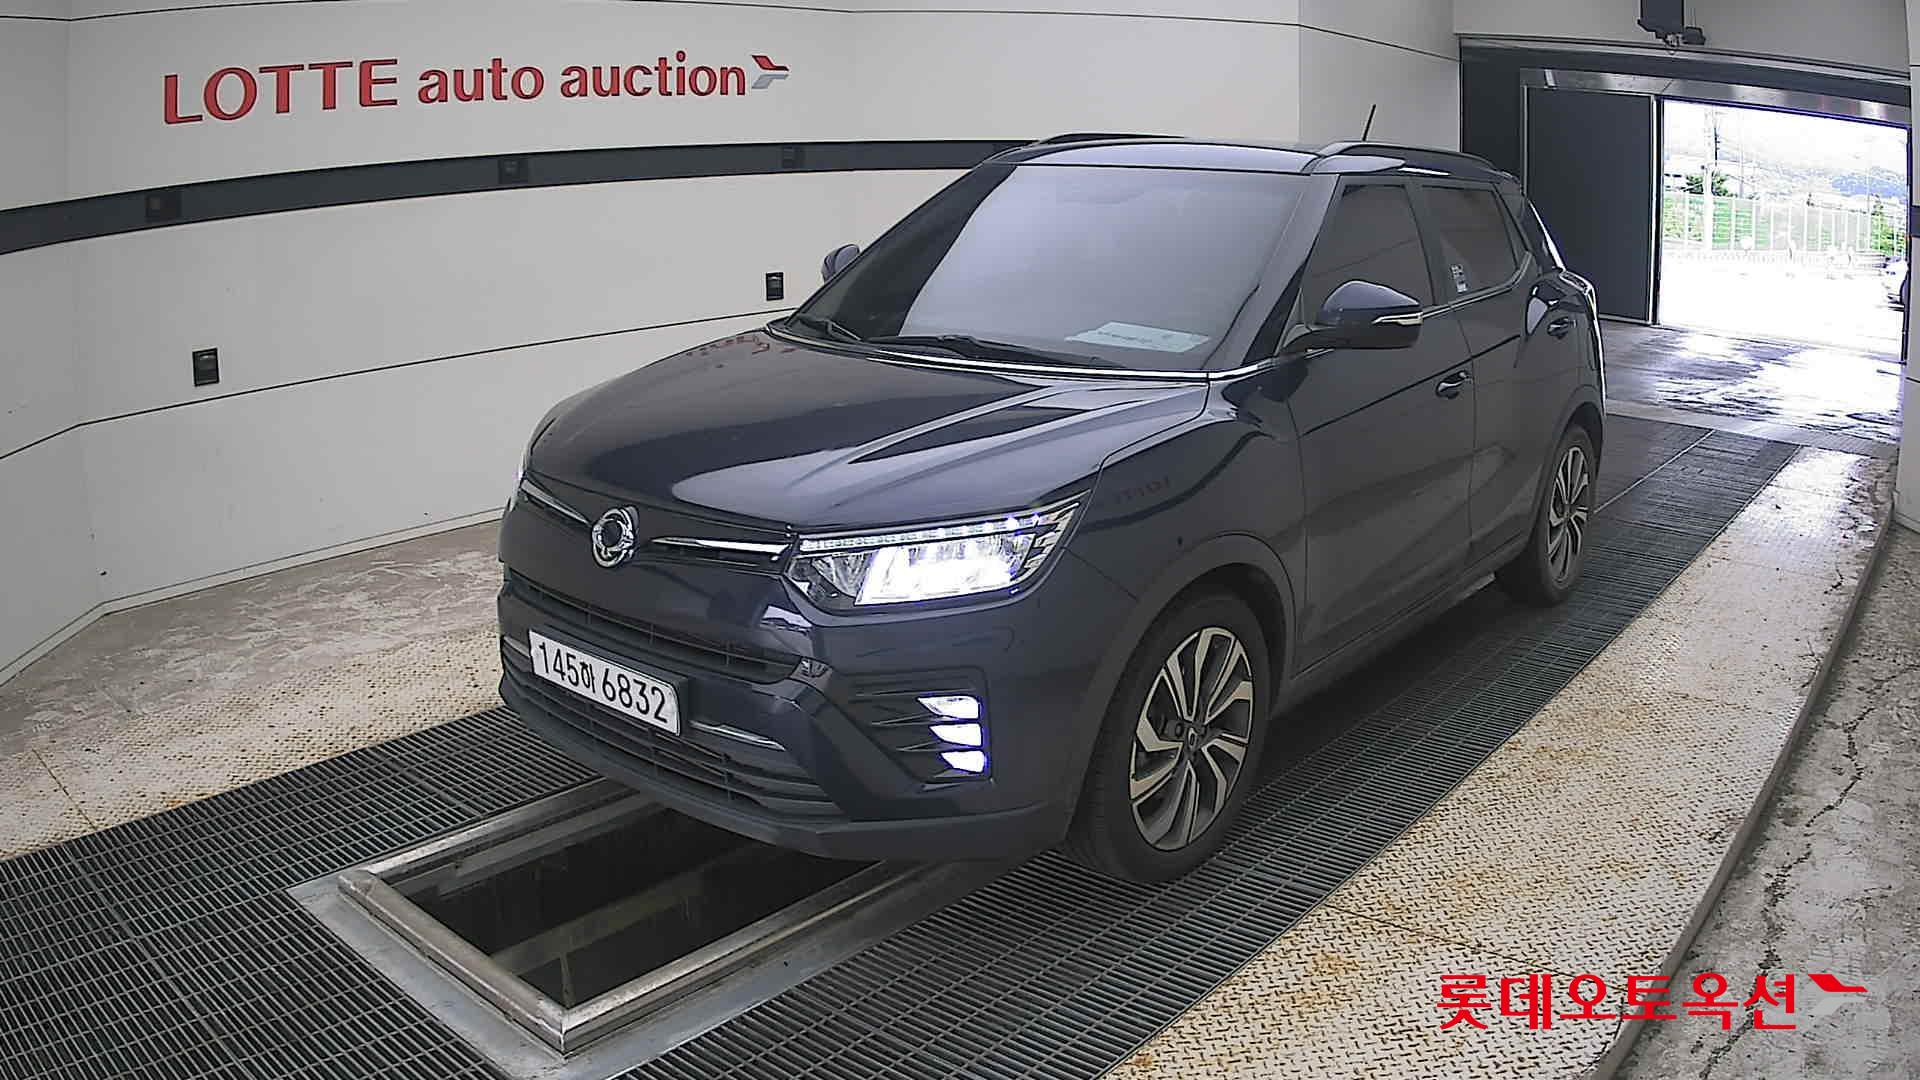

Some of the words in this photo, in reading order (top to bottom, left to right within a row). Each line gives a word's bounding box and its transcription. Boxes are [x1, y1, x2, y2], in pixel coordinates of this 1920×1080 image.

[164, 58, 398, 124] LOTTE
[417, 58, 544, 104] auto
[560, 50, 747, 98] auction
[601, 668, 668, 723] 6832
